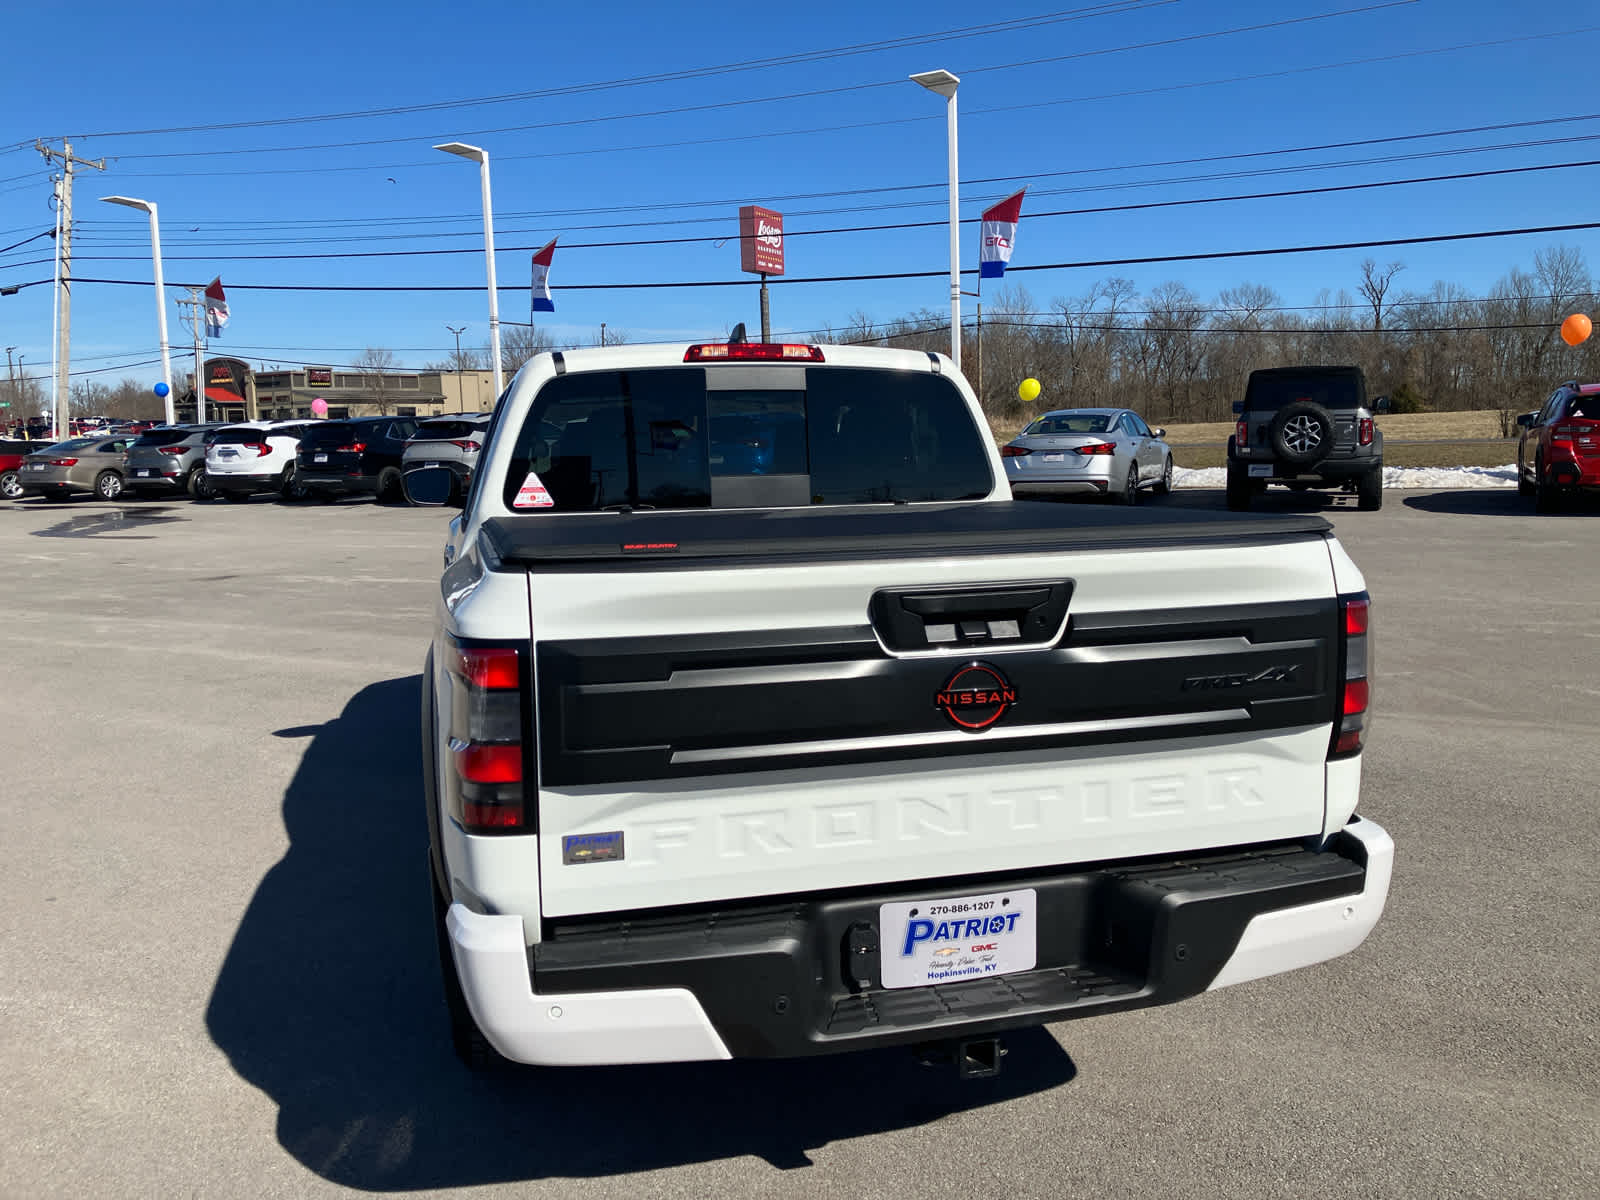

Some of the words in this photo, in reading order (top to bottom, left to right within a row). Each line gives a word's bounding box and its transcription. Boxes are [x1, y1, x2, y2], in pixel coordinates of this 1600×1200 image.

[936, 690, 1016, 705] NISSAN
[625, 764, 1265, 868] FRONTIER
[930, 901, 995, 915] 270-886-1207
[903, 912, 1021, 956] PATRIOT
[971, 942, 998, 953] GMC
[927, 966, 983, 979] Hopkinsville,
[984, 963, 998, 972] KY
